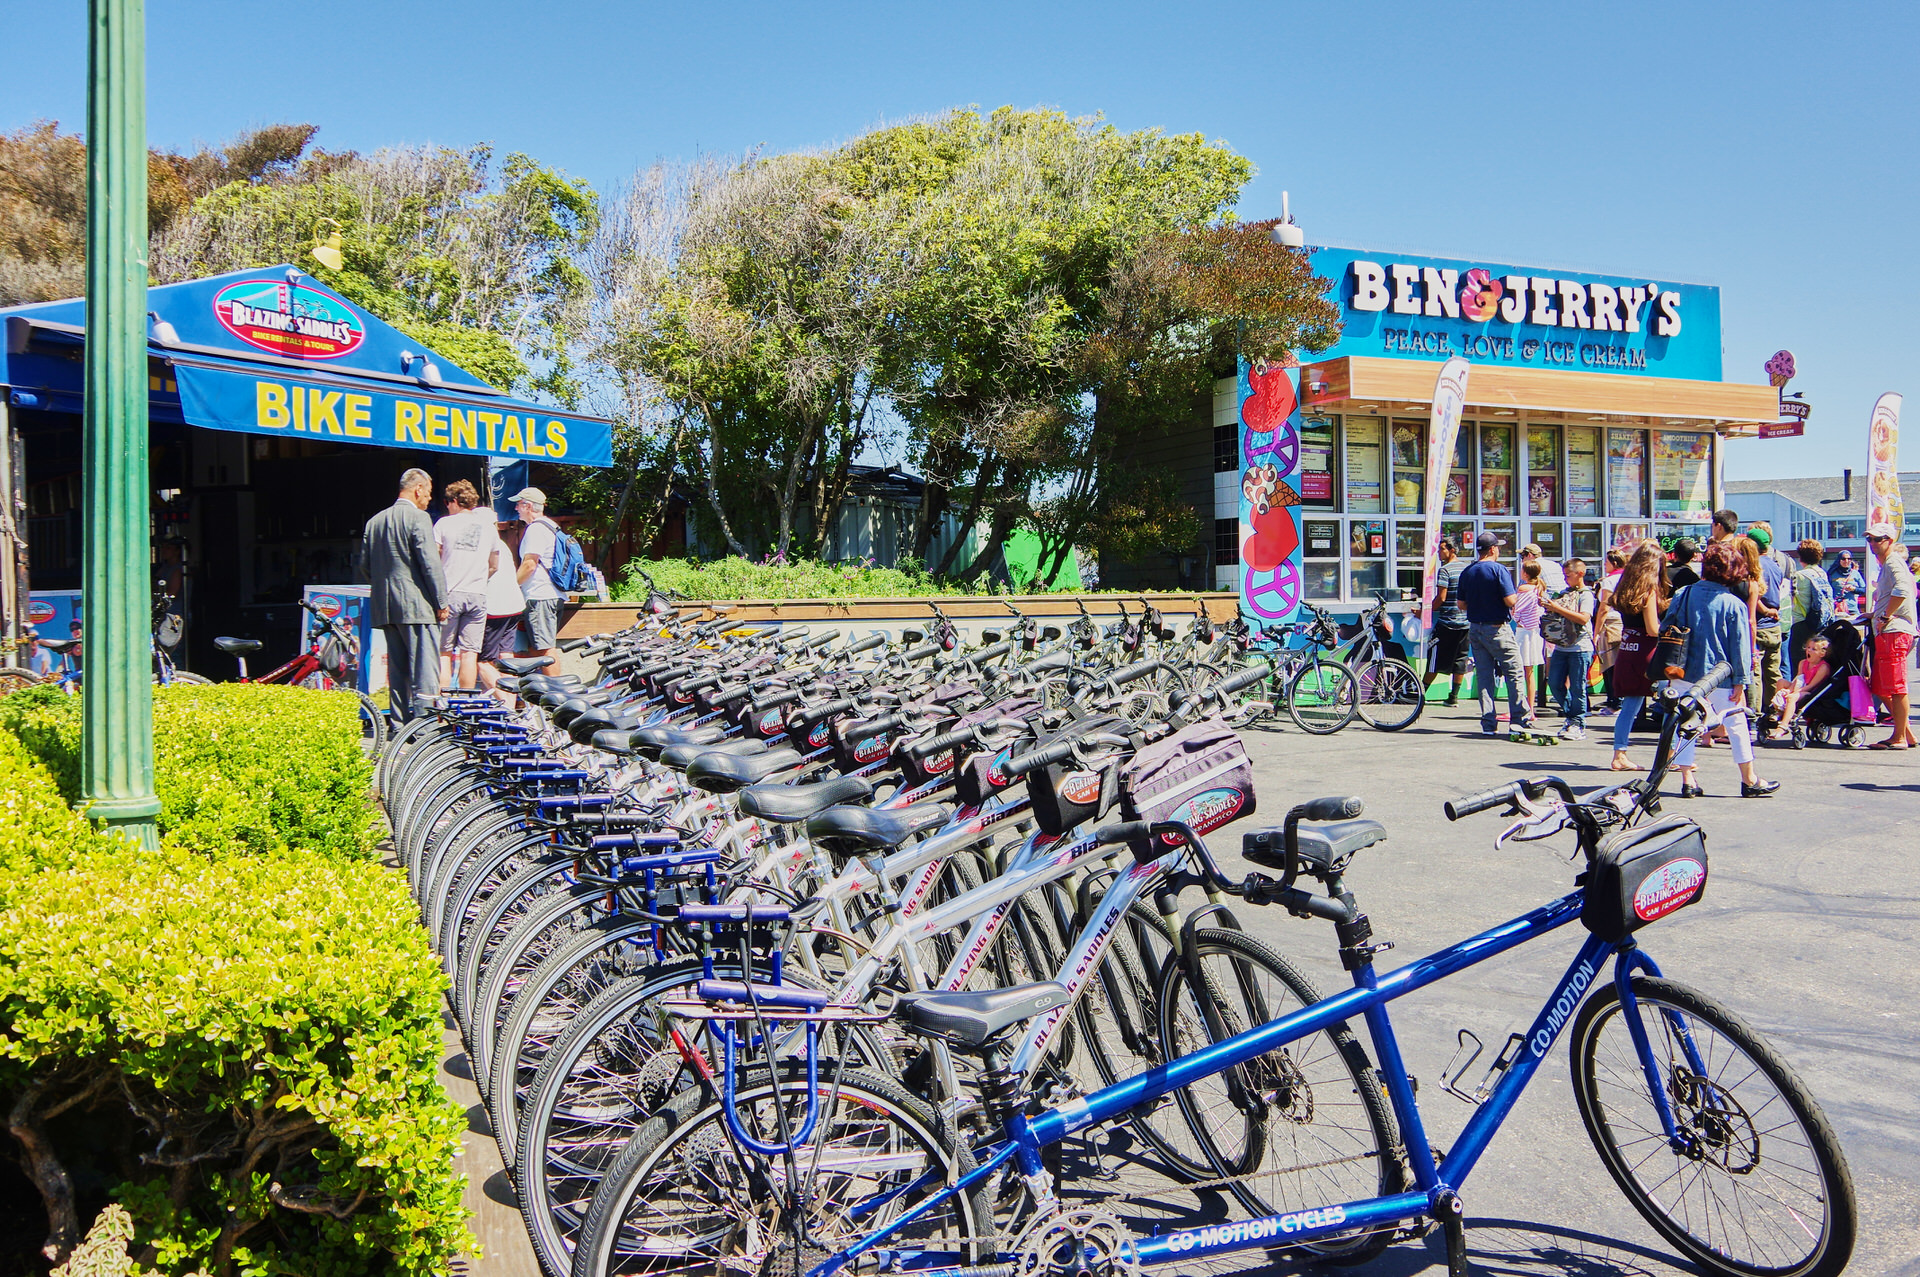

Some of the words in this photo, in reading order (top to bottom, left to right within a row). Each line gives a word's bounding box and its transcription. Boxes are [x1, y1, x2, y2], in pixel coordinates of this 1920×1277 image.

[1353, 260, 1460, 318] BEN
[1500, 275, 1682, 337] JERRY'S
[231, 300, 295, 333] BLAZING
[252, 331, 270, 342] BIKE
[271, 334, 302, 346] RENTALS
[311, 341, 335, 351] TOURS
[1385, 329, 1455, 355] PEACE,
[1464, 333, 1514, 359] LOVE
[1521, 339, 1539, 359] &
[1543, 341, 1575, 363] ICE
[1581, 344, 1648, 369] CREAM
[256, 381, 372, 438] BIKE
[395, 400, 567, 458] RENTALS
[1780, 403, 1807, 417] ERRY'S
[1077, 789, 1091, 800] SAN
[1071, 840, 1102, 860] Bla
[1639, 884, 1673, 910] BLAZING
[1646, 906, 1660, 917] SAN
[948, 934, 987, 991] BLAZING
[1034, 978, 1077, 1050] BLAZG
[1076, 906, 1120, 978] SADDLES
[1280, 1206, 1346, 1233] CYCLES
